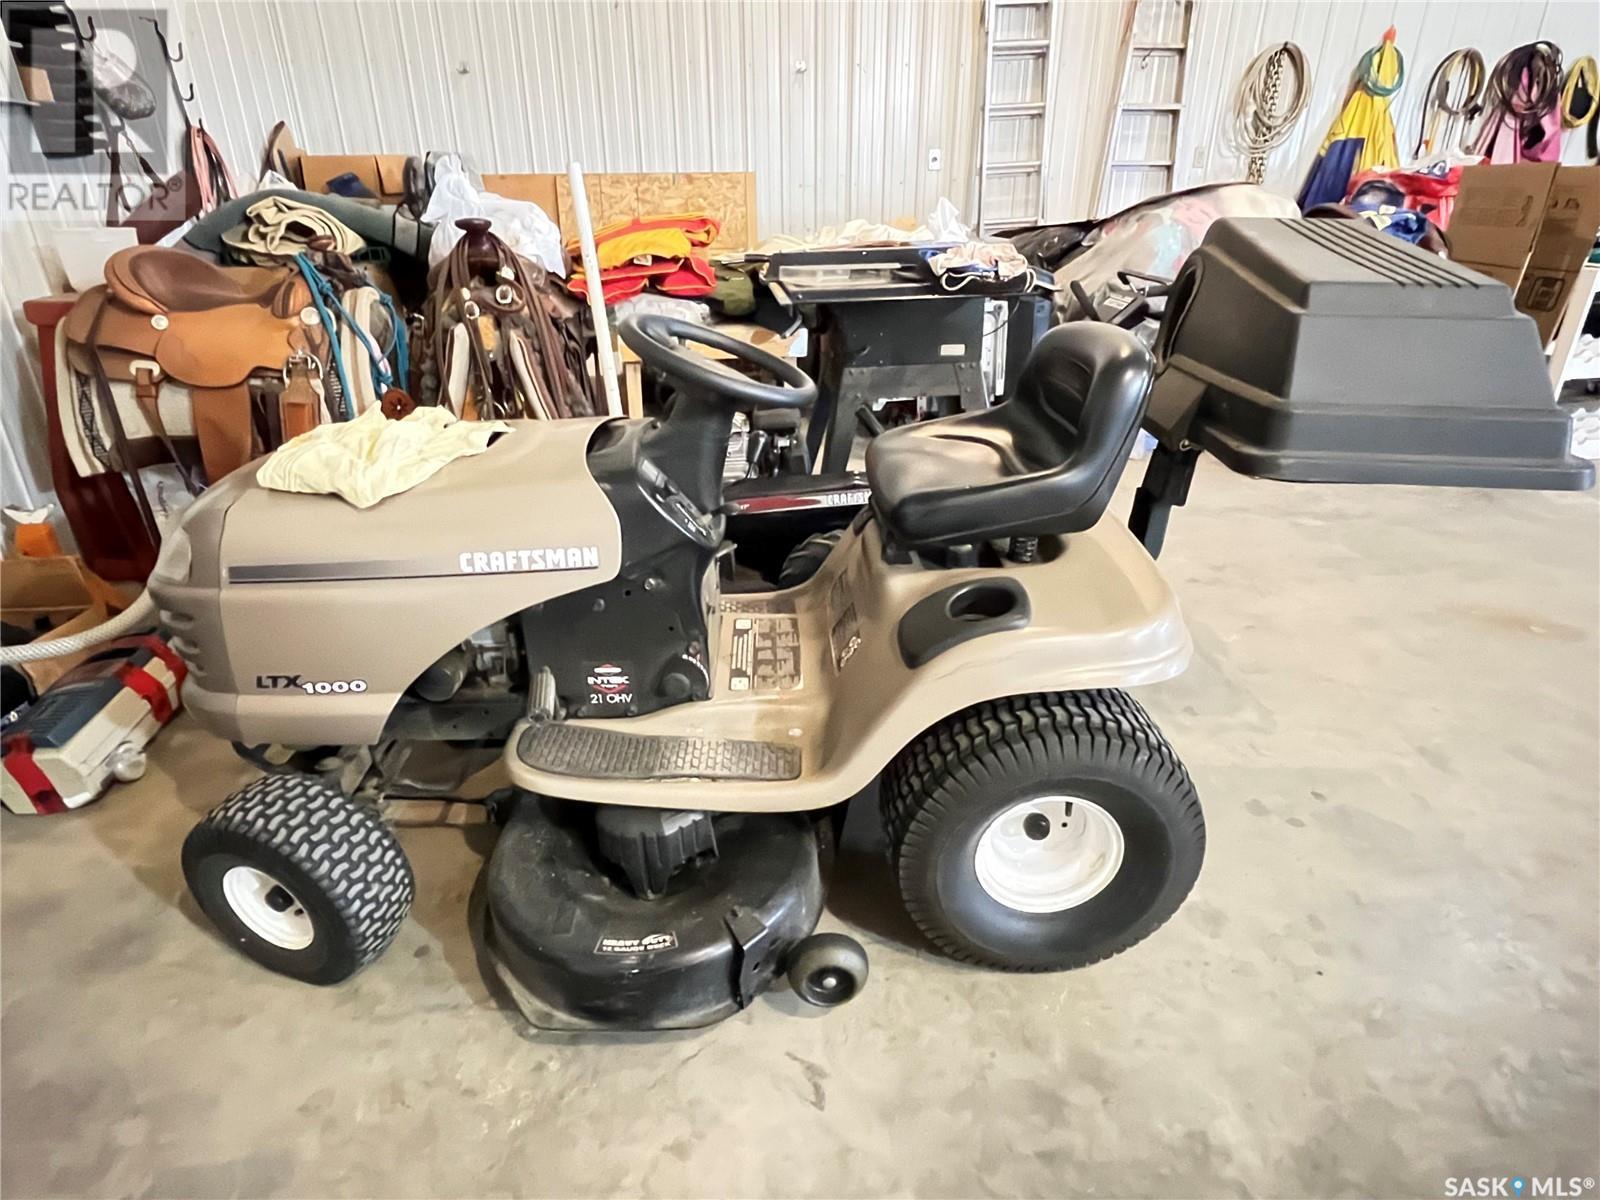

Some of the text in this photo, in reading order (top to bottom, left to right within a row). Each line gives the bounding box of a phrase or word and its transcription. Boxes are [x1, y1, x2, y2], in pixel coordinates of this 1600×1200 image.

[459, 547, 598, 572] CRAFTSMAN
[590, 693, 633, 704] 21 OHV
